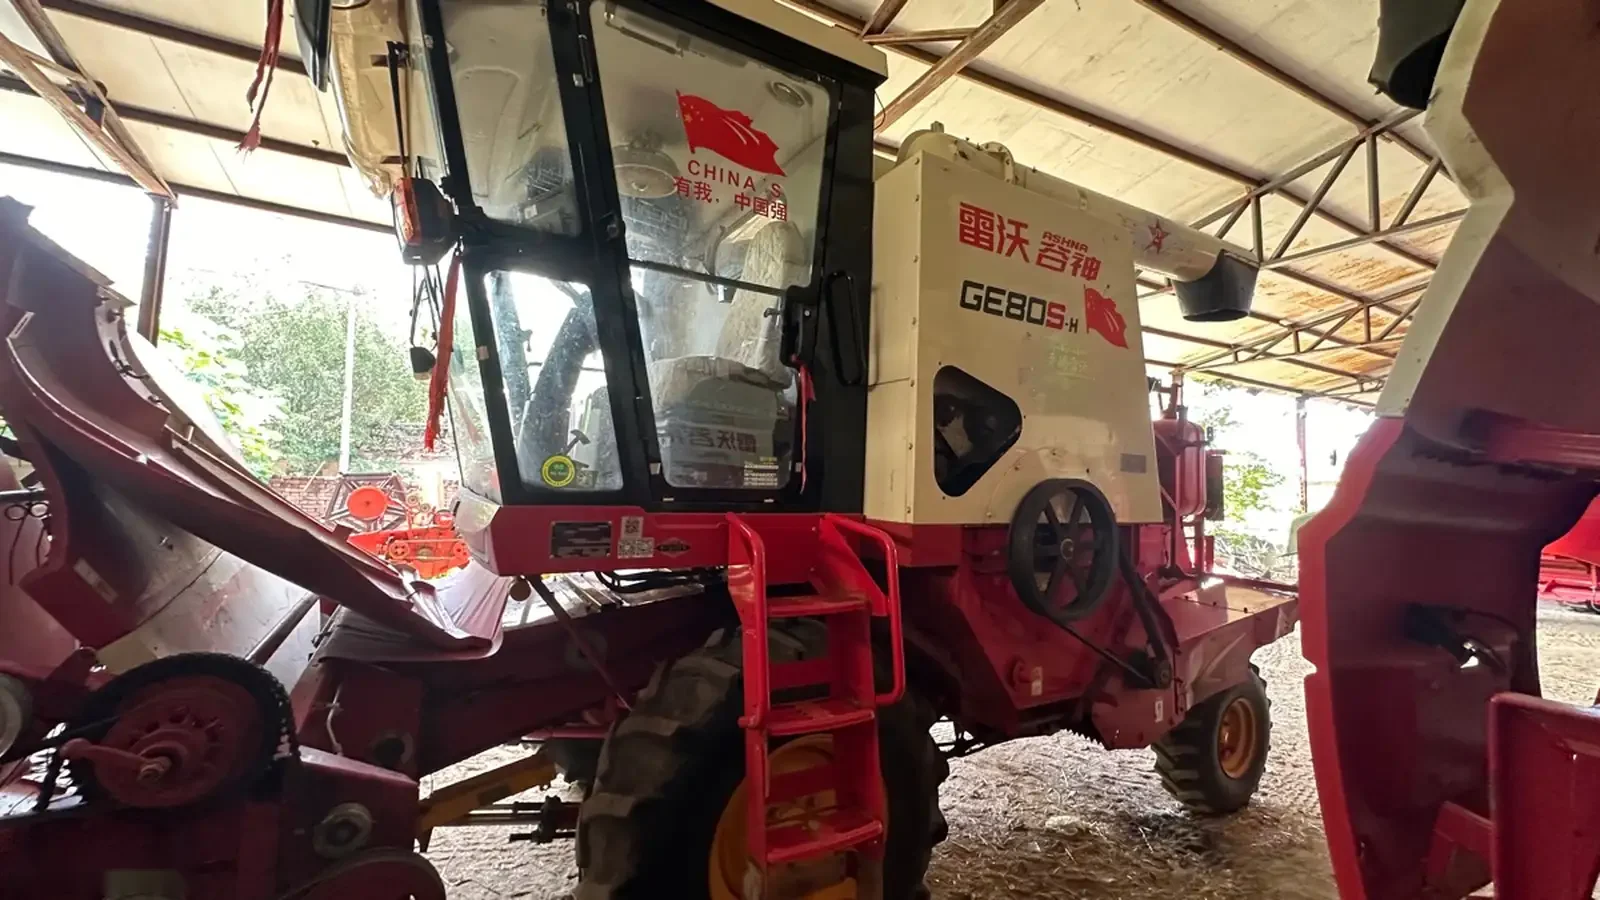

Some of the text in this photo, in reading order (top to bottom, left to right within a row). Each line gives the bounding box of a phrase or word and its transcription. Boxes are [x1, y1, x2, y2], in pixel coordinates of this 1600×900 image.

[959, 202, 1101, 281] 雷沃 谷神
[1042, 231, 1088, 253] ASHNA
